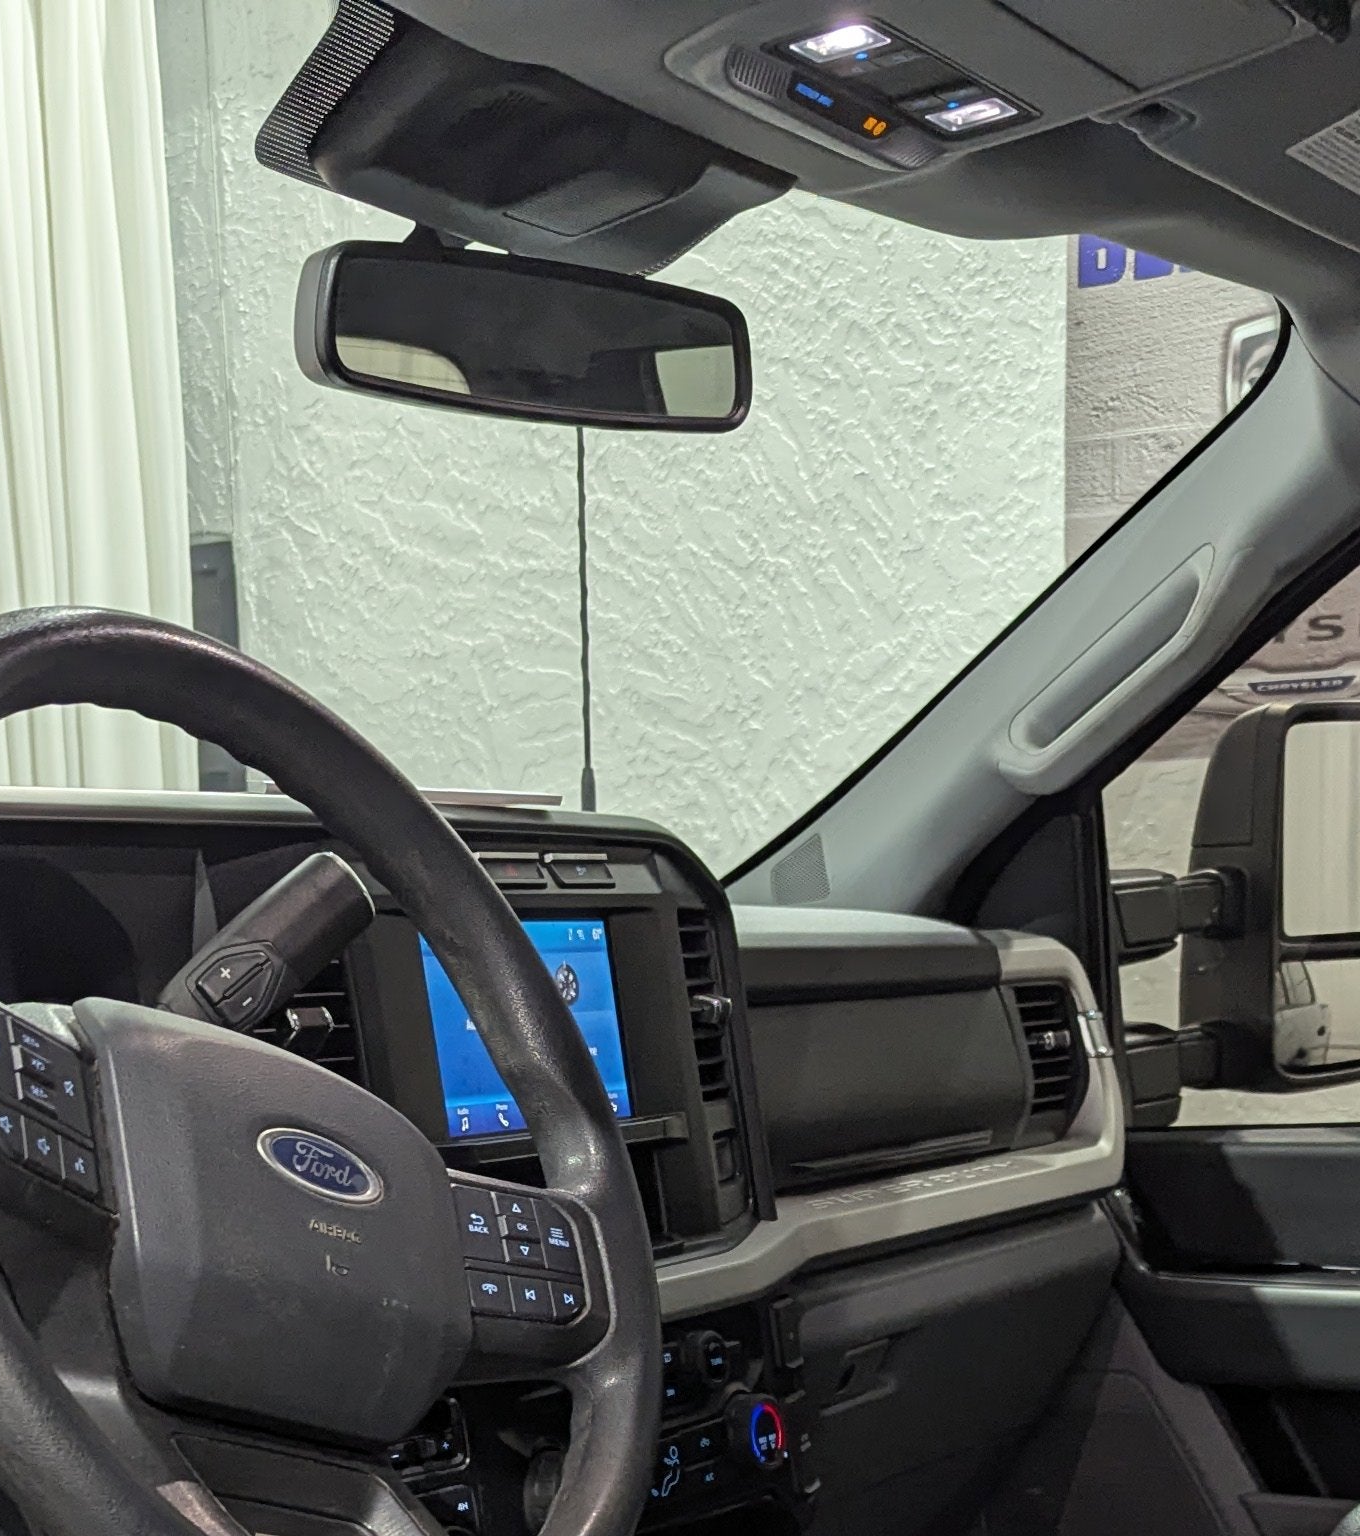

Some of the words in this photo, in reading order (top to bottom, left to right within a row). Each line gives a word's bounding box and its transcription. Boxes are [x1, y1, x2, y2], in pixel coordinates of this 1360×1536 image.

[292, 1141, 352, 1187] Ford
[468, 1223, 489, 1235] BACK
[548, 1236, 570, 1248] MENU
